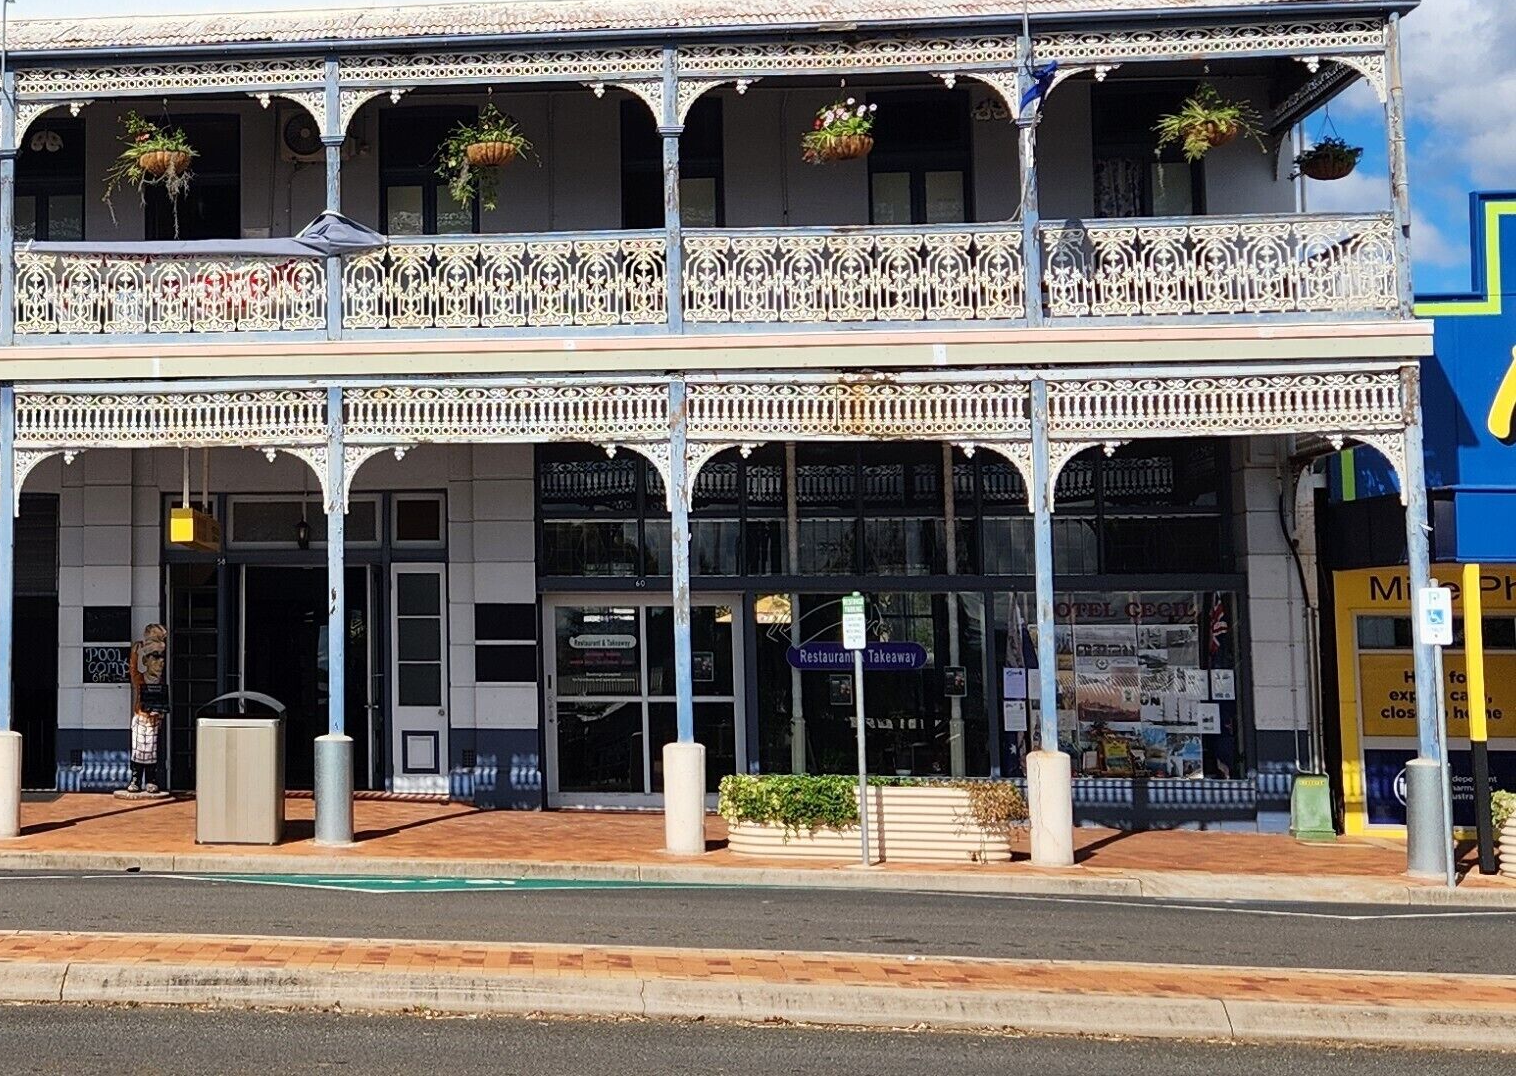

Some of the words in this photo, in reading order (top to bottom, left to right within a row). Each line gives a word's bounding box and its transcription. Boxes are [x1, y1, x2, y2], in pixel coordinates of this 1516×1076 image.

[635, 580, 646, 588] 60
[1369, 575, 1461, 601] Mie
[1053, 602, 1117, 618] OTEL
[799, 649, 855, 663] Restaurant
[868, 649, 917, 666] Takeaway
[1448, 670, 1467, 683] fo
[1381, 705, 1416, 719] clos
